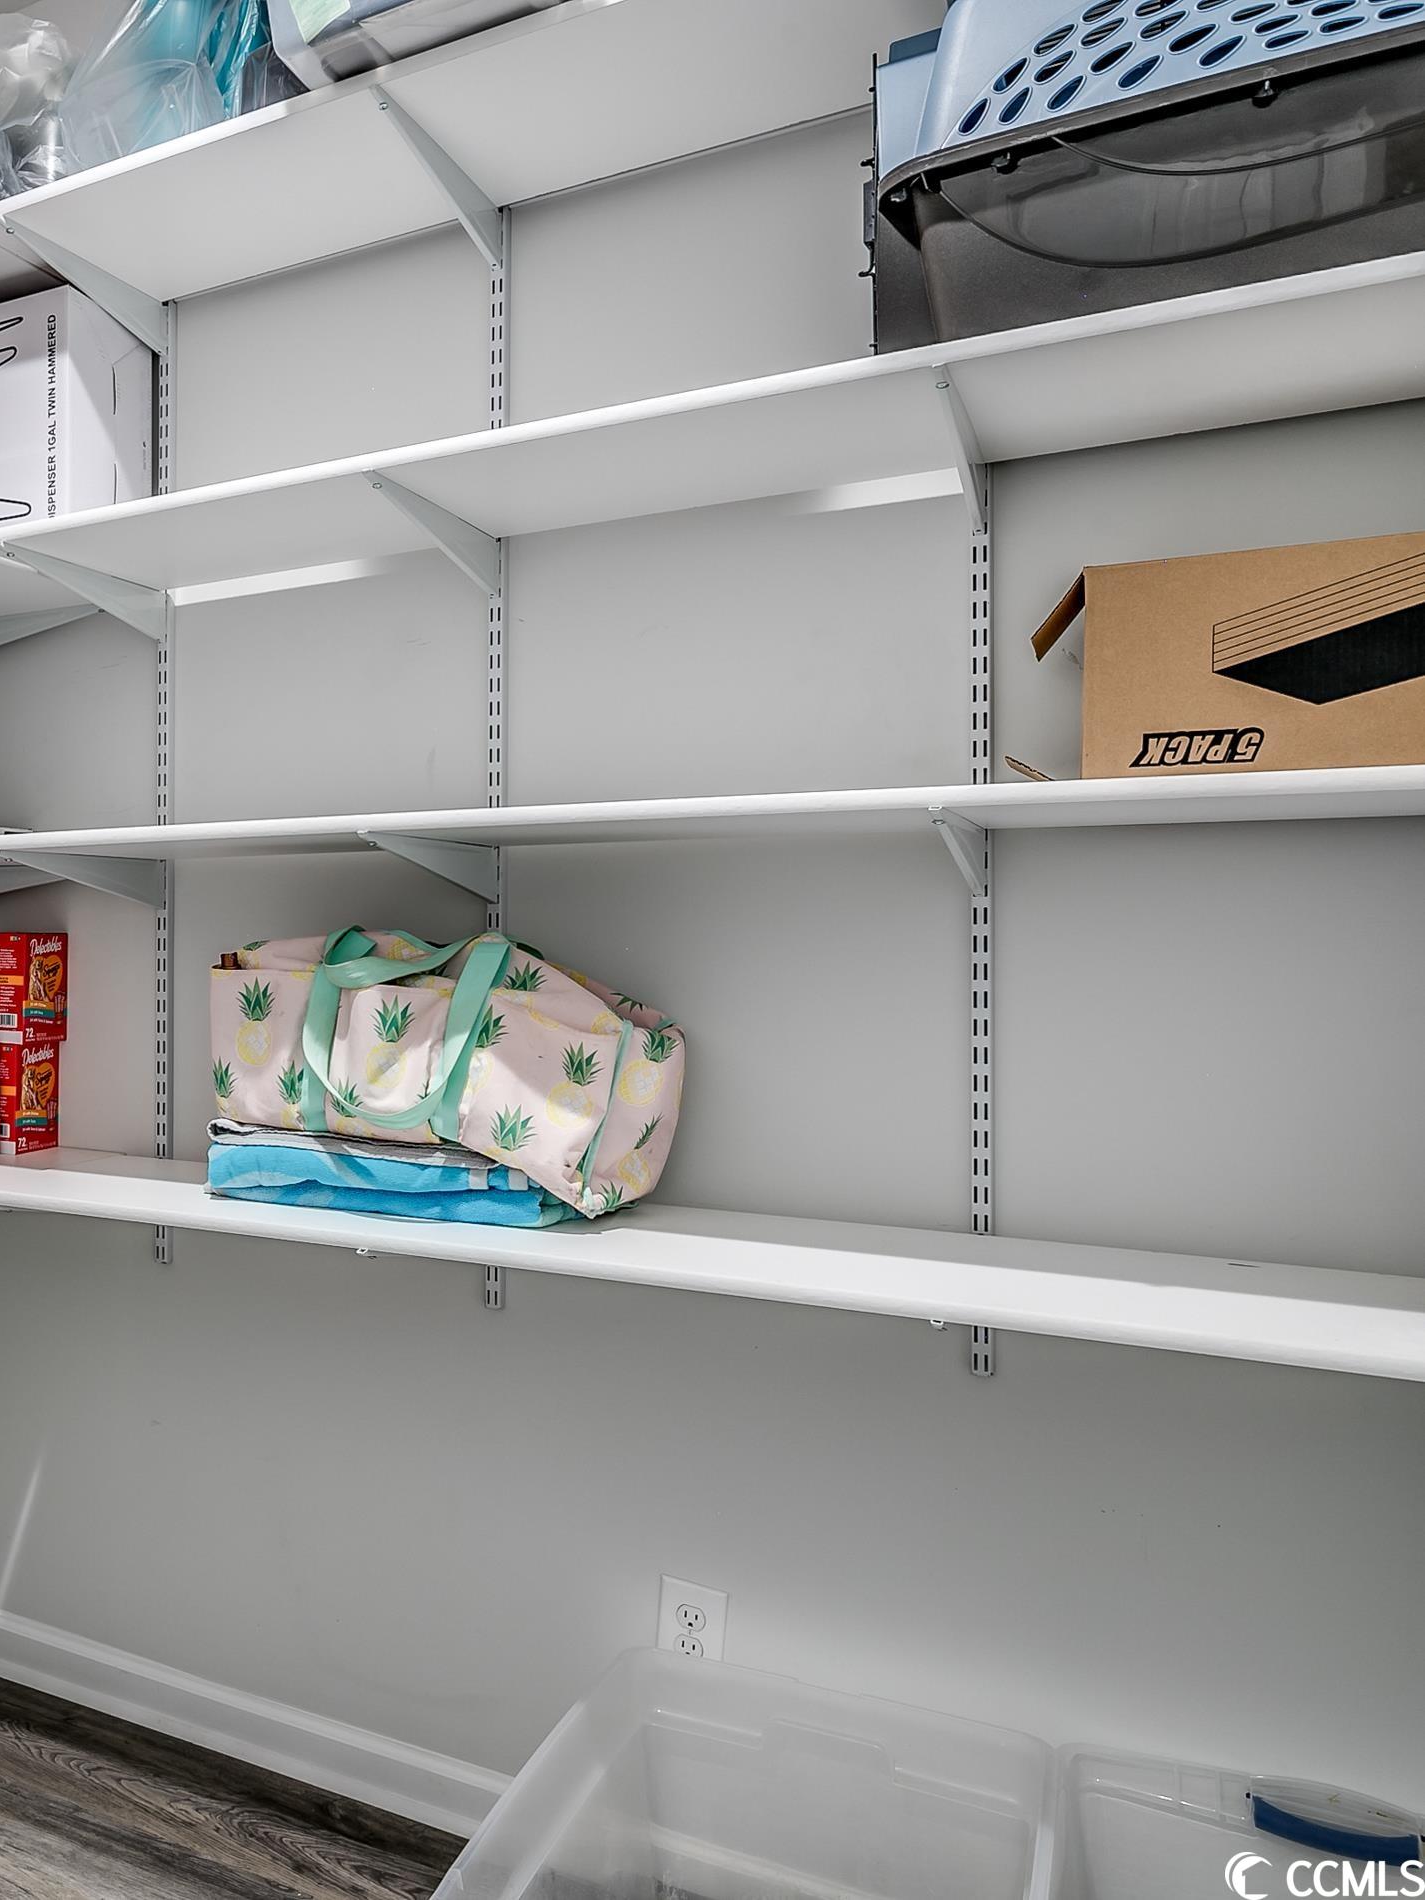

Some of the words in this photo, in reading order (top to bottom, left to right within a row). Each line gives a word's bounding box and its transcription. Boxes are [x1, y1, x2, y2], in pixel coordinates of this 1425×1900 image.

[47, 314, 57, 385] HAMMERED
[47, 387, 57, 418] TWIN
[47, 420, 57, 451] 1GAL
[1138, 734, 1234, 765] PACK
[1234, 732, 1261, 761] 5
[30, 936, 62, 957] Delectables
[25, 1028, 34, 1038] 72
[22, 1043, 55, 1067] Delectables
[18, 1137, 27, 1148] 72
